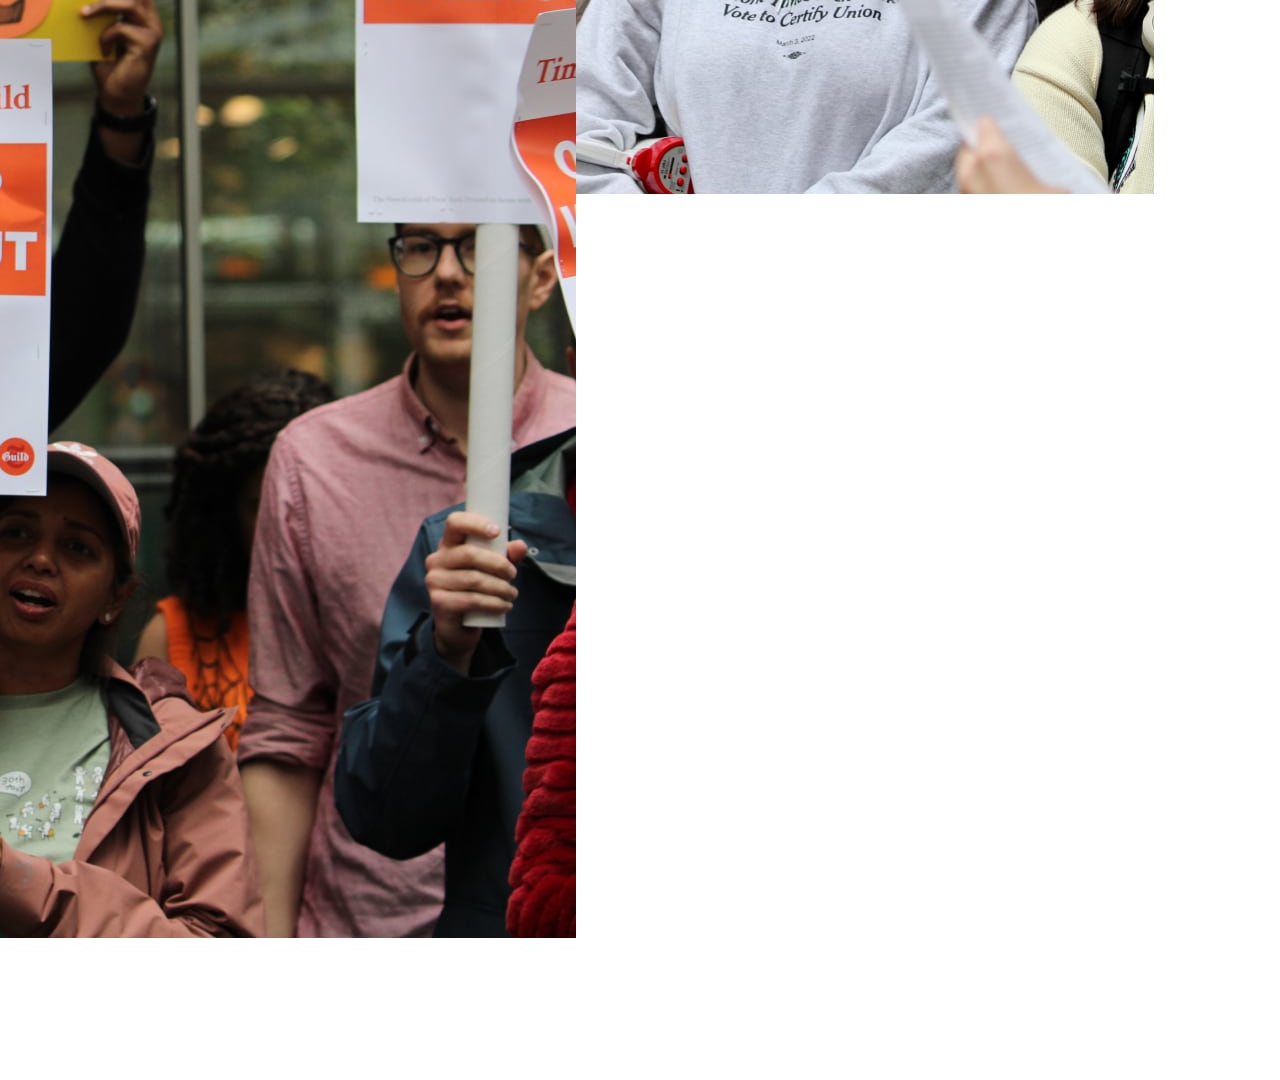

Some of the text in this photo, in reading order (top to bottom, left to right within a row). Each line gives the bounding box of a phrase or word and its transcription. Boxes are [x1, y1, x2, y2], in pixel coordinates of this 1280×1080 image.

[723, 4, 882, 27] Vote to Certify Union
[2, 451, 30, 462] Guild
